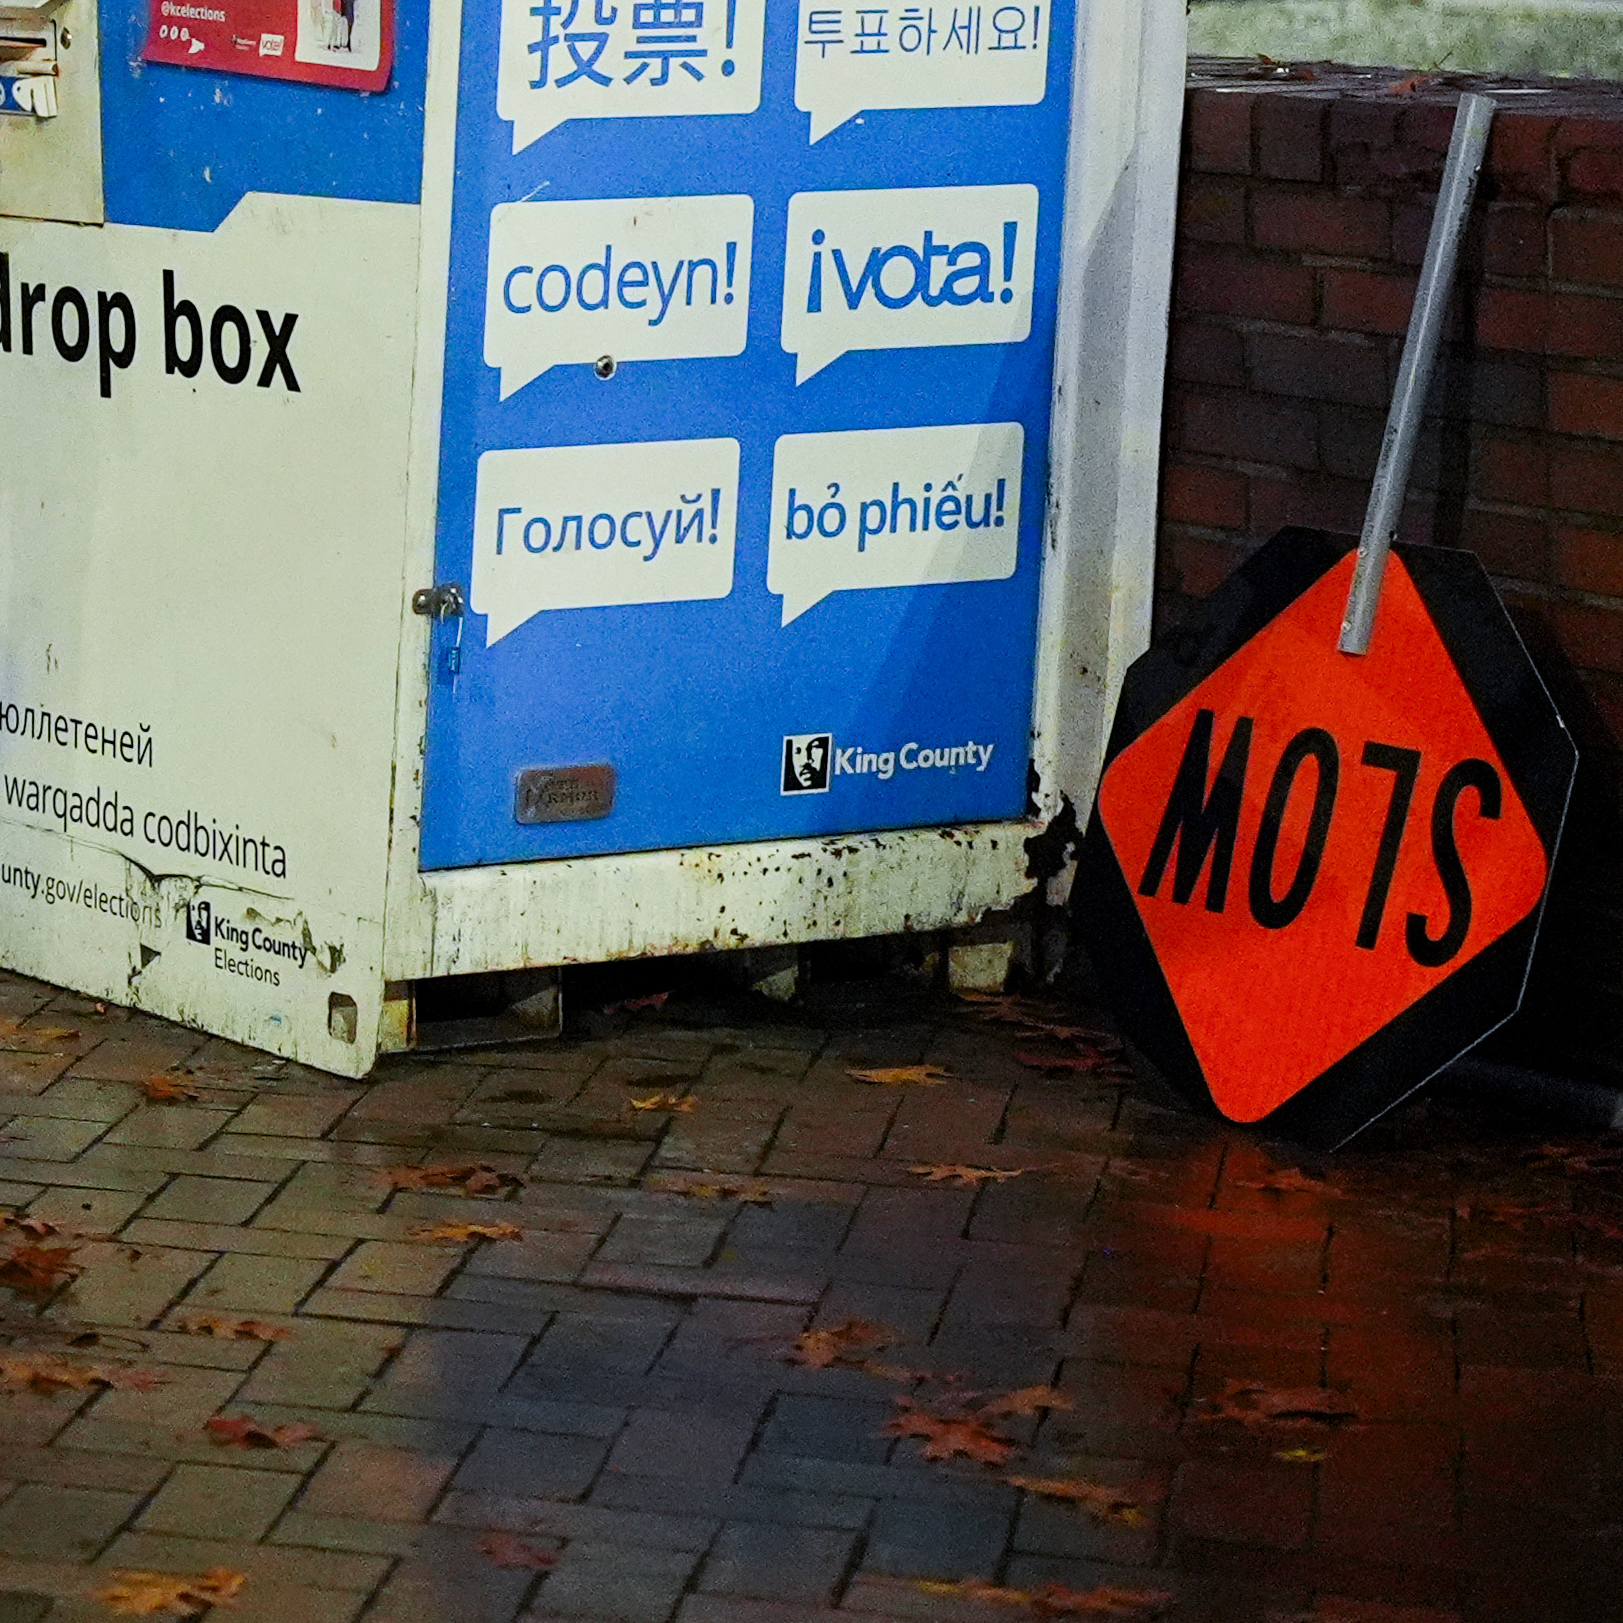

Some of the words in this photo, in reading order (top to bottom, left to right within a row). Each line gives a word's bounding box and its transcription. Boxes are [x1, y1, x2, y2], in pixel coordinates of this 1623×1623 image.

[160, 0, 226, 23] @kcelections
[802, 4, 1042, 59] 투표하세요!
[503, 241, 738, 327] codeyn!
[805, 221, 1019, 314] ¡vota!
[162, 268, 301, 393] box
[494, 487, 722, 562] Голосуй!
[785, 483, 847, 541] bỏ
[858, 476, 1007, 553] phiếu!
[834, 746, 895, 780] King
[899, 740, 994, 772] County
[4, 774, 134, 838] warqadda
[143, 809, 287, 880] codbixinta
[214, 915, 250, 952] King
[251, 927, 307, 969] County
[214, 947, 281, 987] Elections
